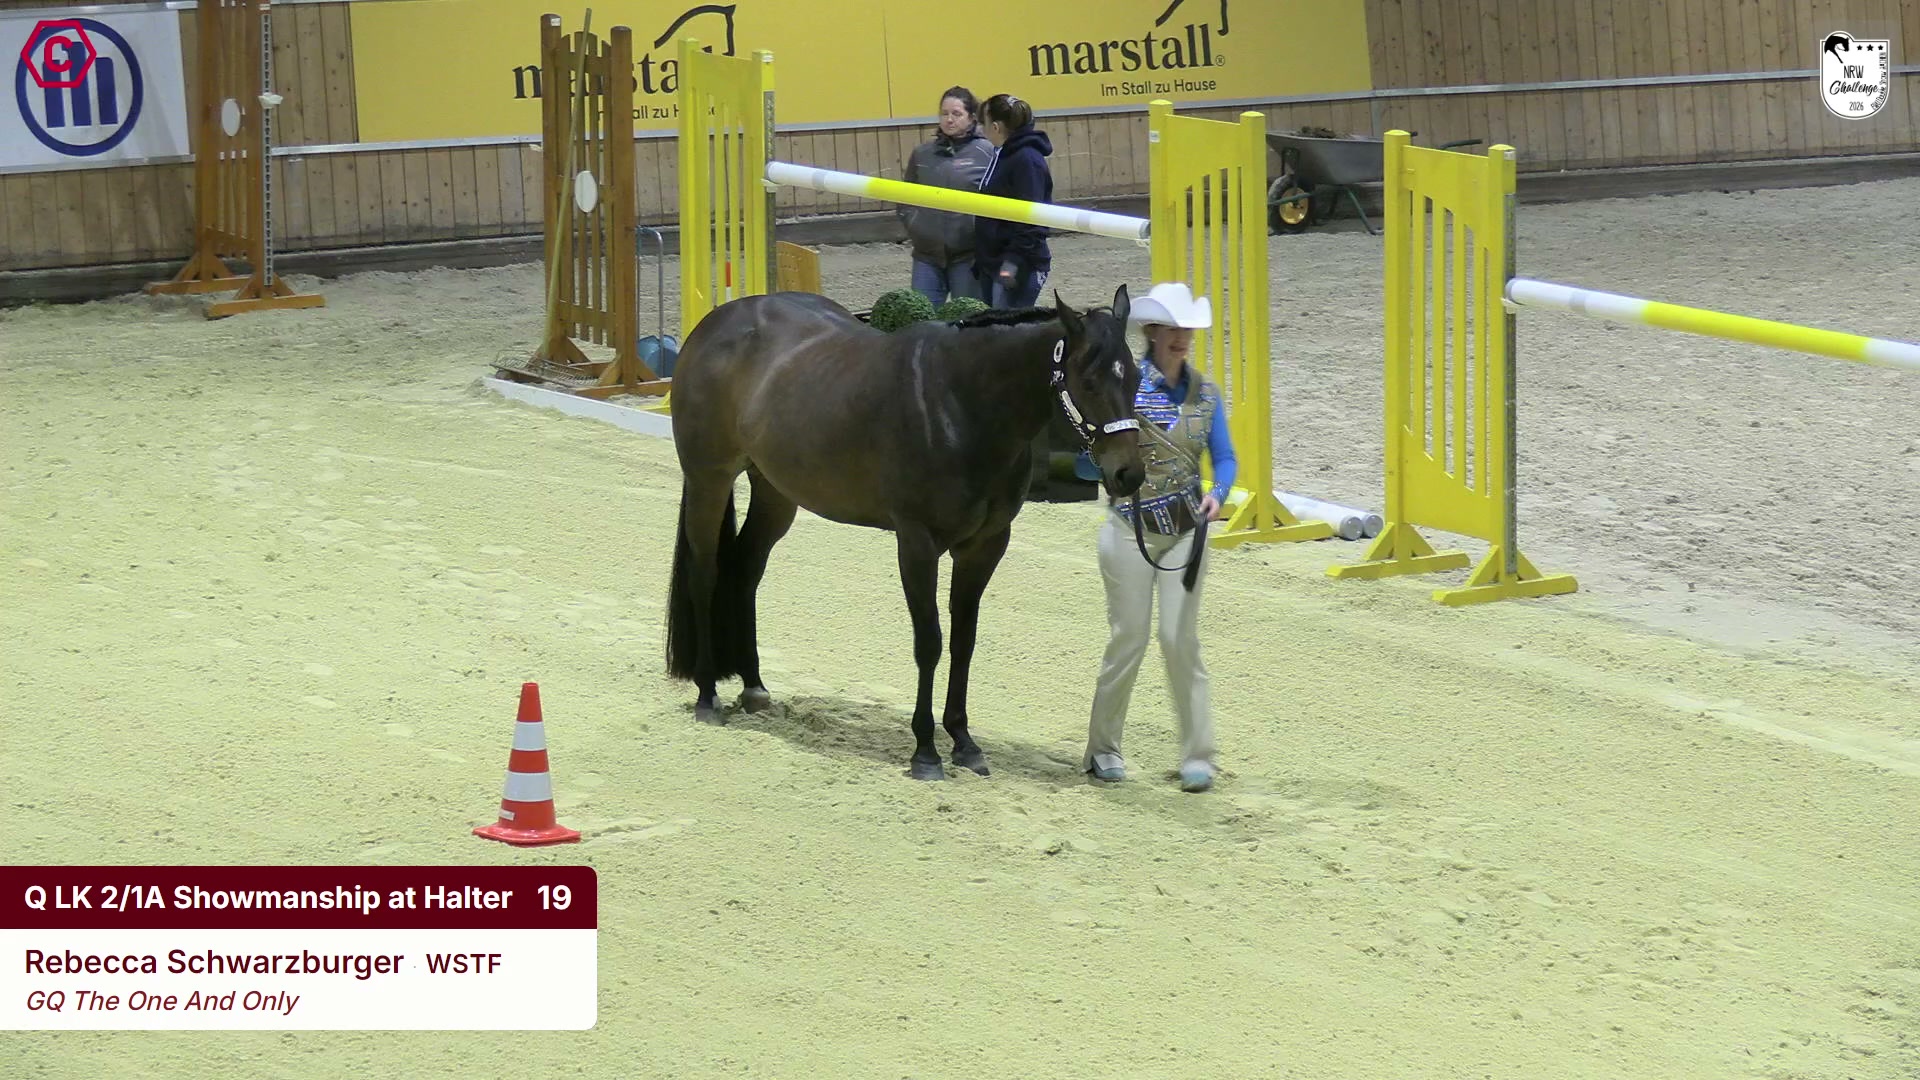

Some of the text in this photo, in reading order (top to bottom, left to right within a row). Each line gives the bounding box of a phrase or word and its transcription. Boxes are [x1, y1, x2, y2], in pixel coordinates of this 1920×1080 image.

[1101, 79, 1217, 97] Im Stall zu Hause
[652, 107, 669, 119] zu
